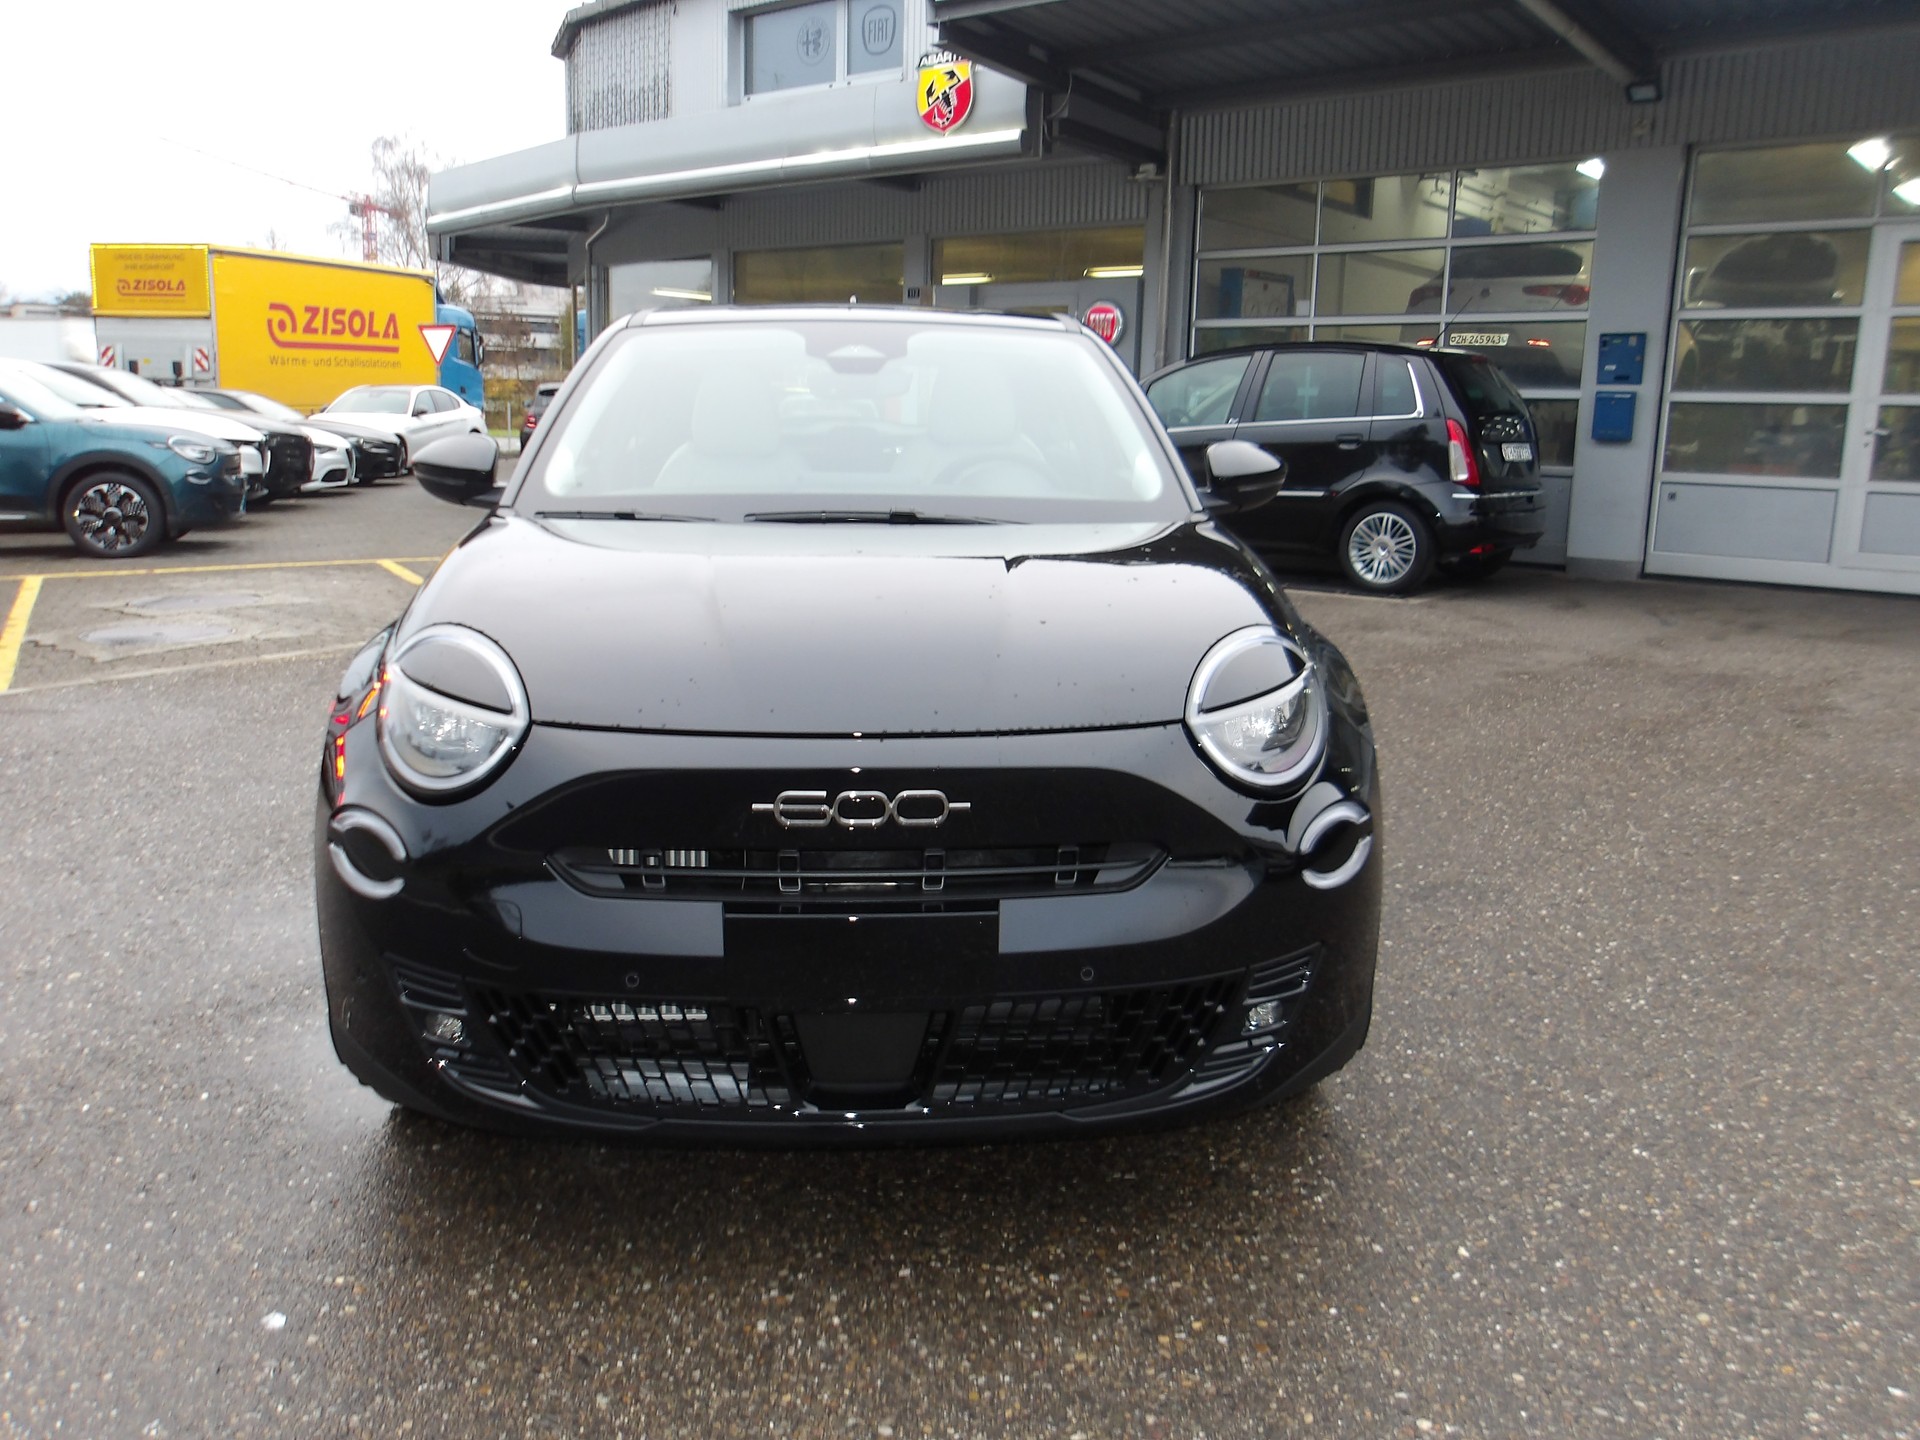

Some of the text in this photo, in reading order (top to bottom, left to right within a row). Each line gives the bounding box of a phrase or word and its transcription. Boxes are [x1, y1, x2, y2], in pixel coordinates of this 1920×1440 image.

[868, 17, 890, 44] FIAT
[919, 51, 963, 67] ABAR
[133, 279, 185, 290] ZISOLA
[302, 305, 400, 340] ZISOLA
[1089, 312, 1114, 338] FIAT
[269, 354, 402, 369] Wärme- und Schallisolationen
[773, 789, 950, 828] 600
